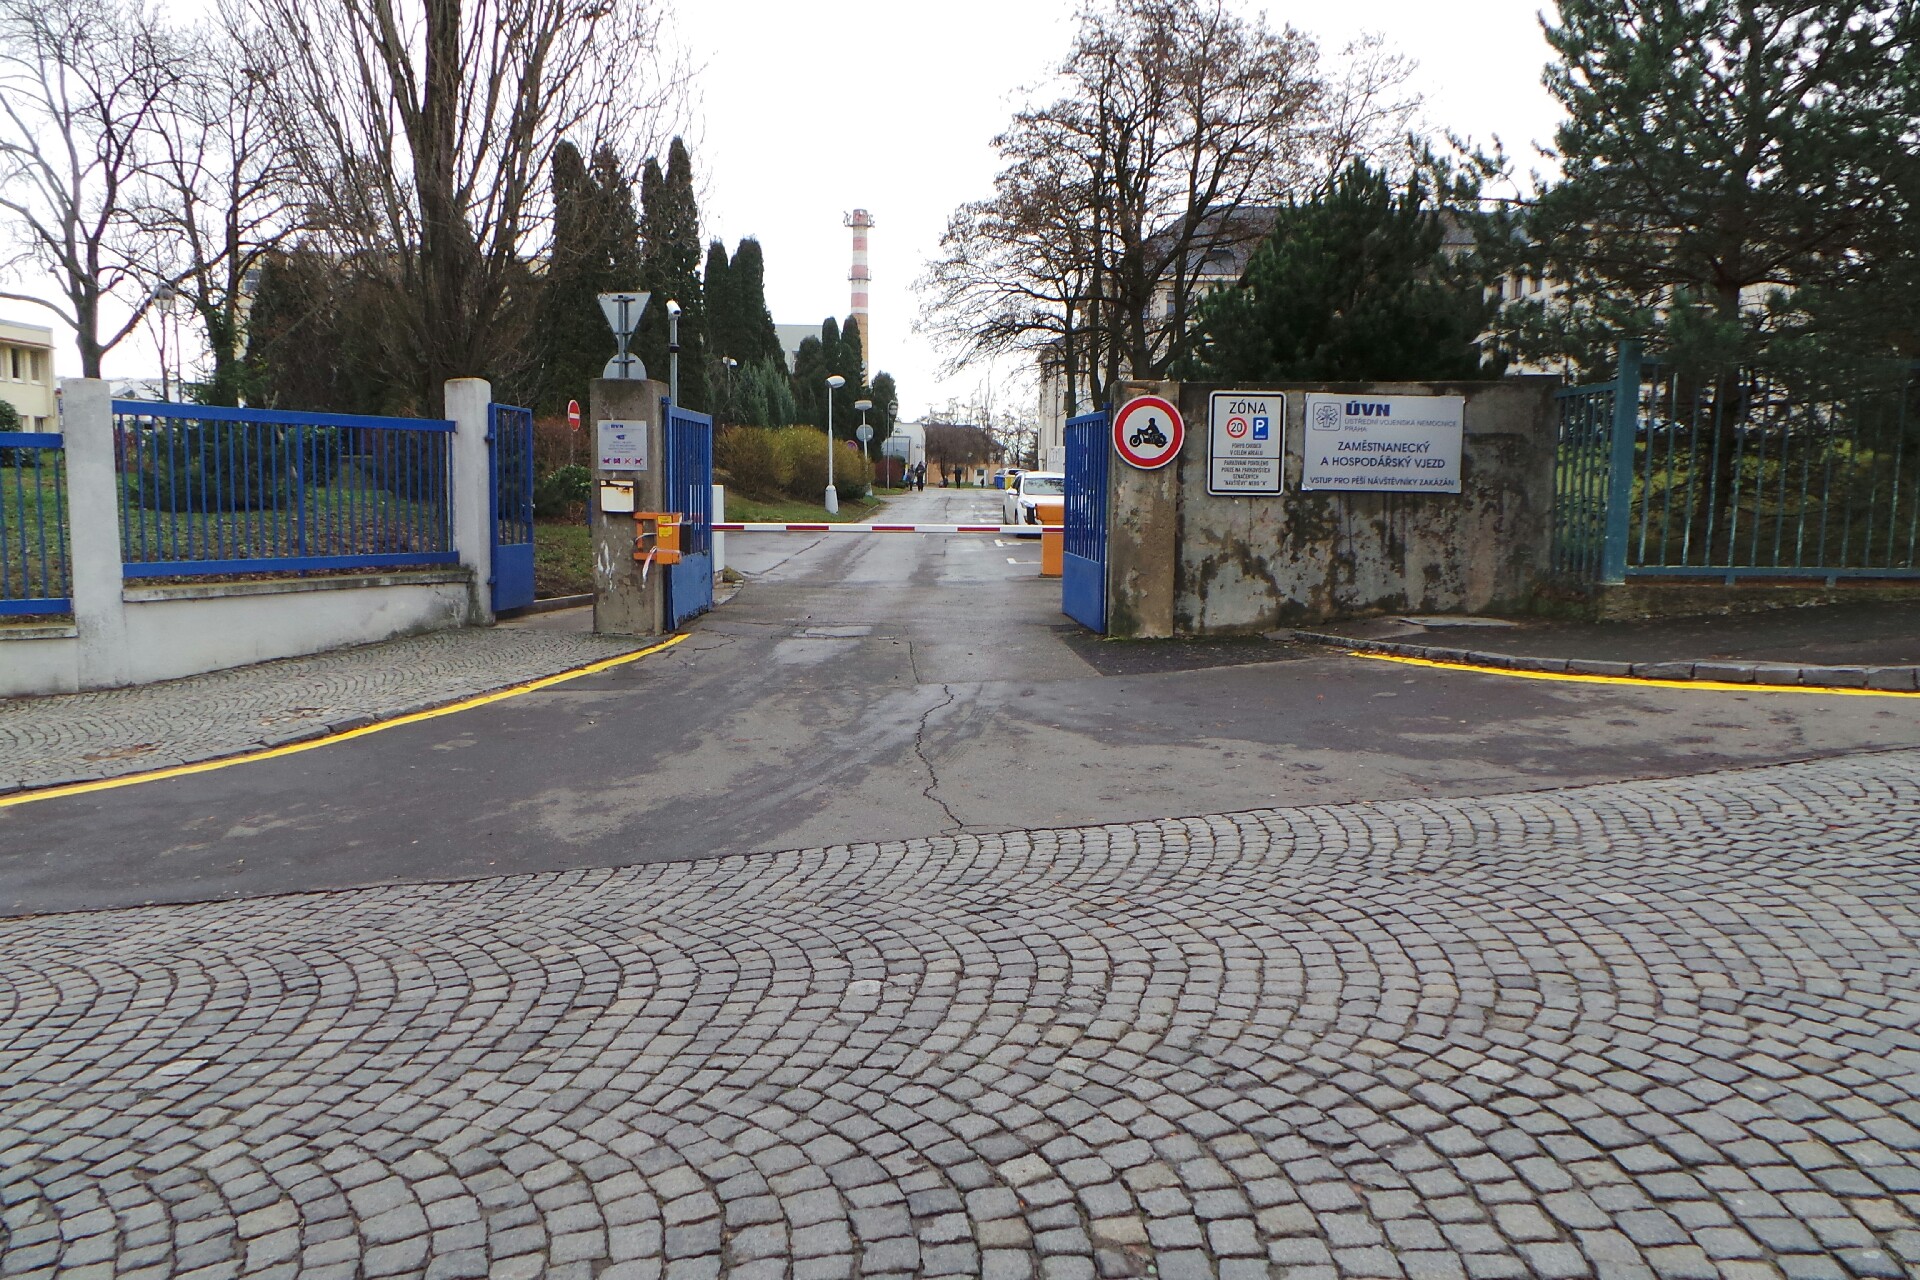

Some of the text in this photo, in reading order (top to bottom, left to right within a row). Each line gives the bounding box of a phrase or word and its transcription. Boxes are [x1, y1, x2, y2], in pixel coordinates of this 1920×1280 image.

[1229, 399, 1267, 415] ZÓNA
[1345, 400, 1391, 417] ÚVN
[1230, 422, 1243, 433] 20
[1255, 419, 1265, 432] P
[1338, 440, 1431, 453] ZAMĚSTNANECKÝ
[1320, 455, 1446, 468] A HOSPODÁŘSKÝ VJEZD
[1310, 476, 1332, 484] VSTUP
[1334, 477, 1350, 485] PRO
[1352, 475, 1366, 485] PĚŠÍ
[1420, 477, 1455, 486] ZAKÁZÁN
